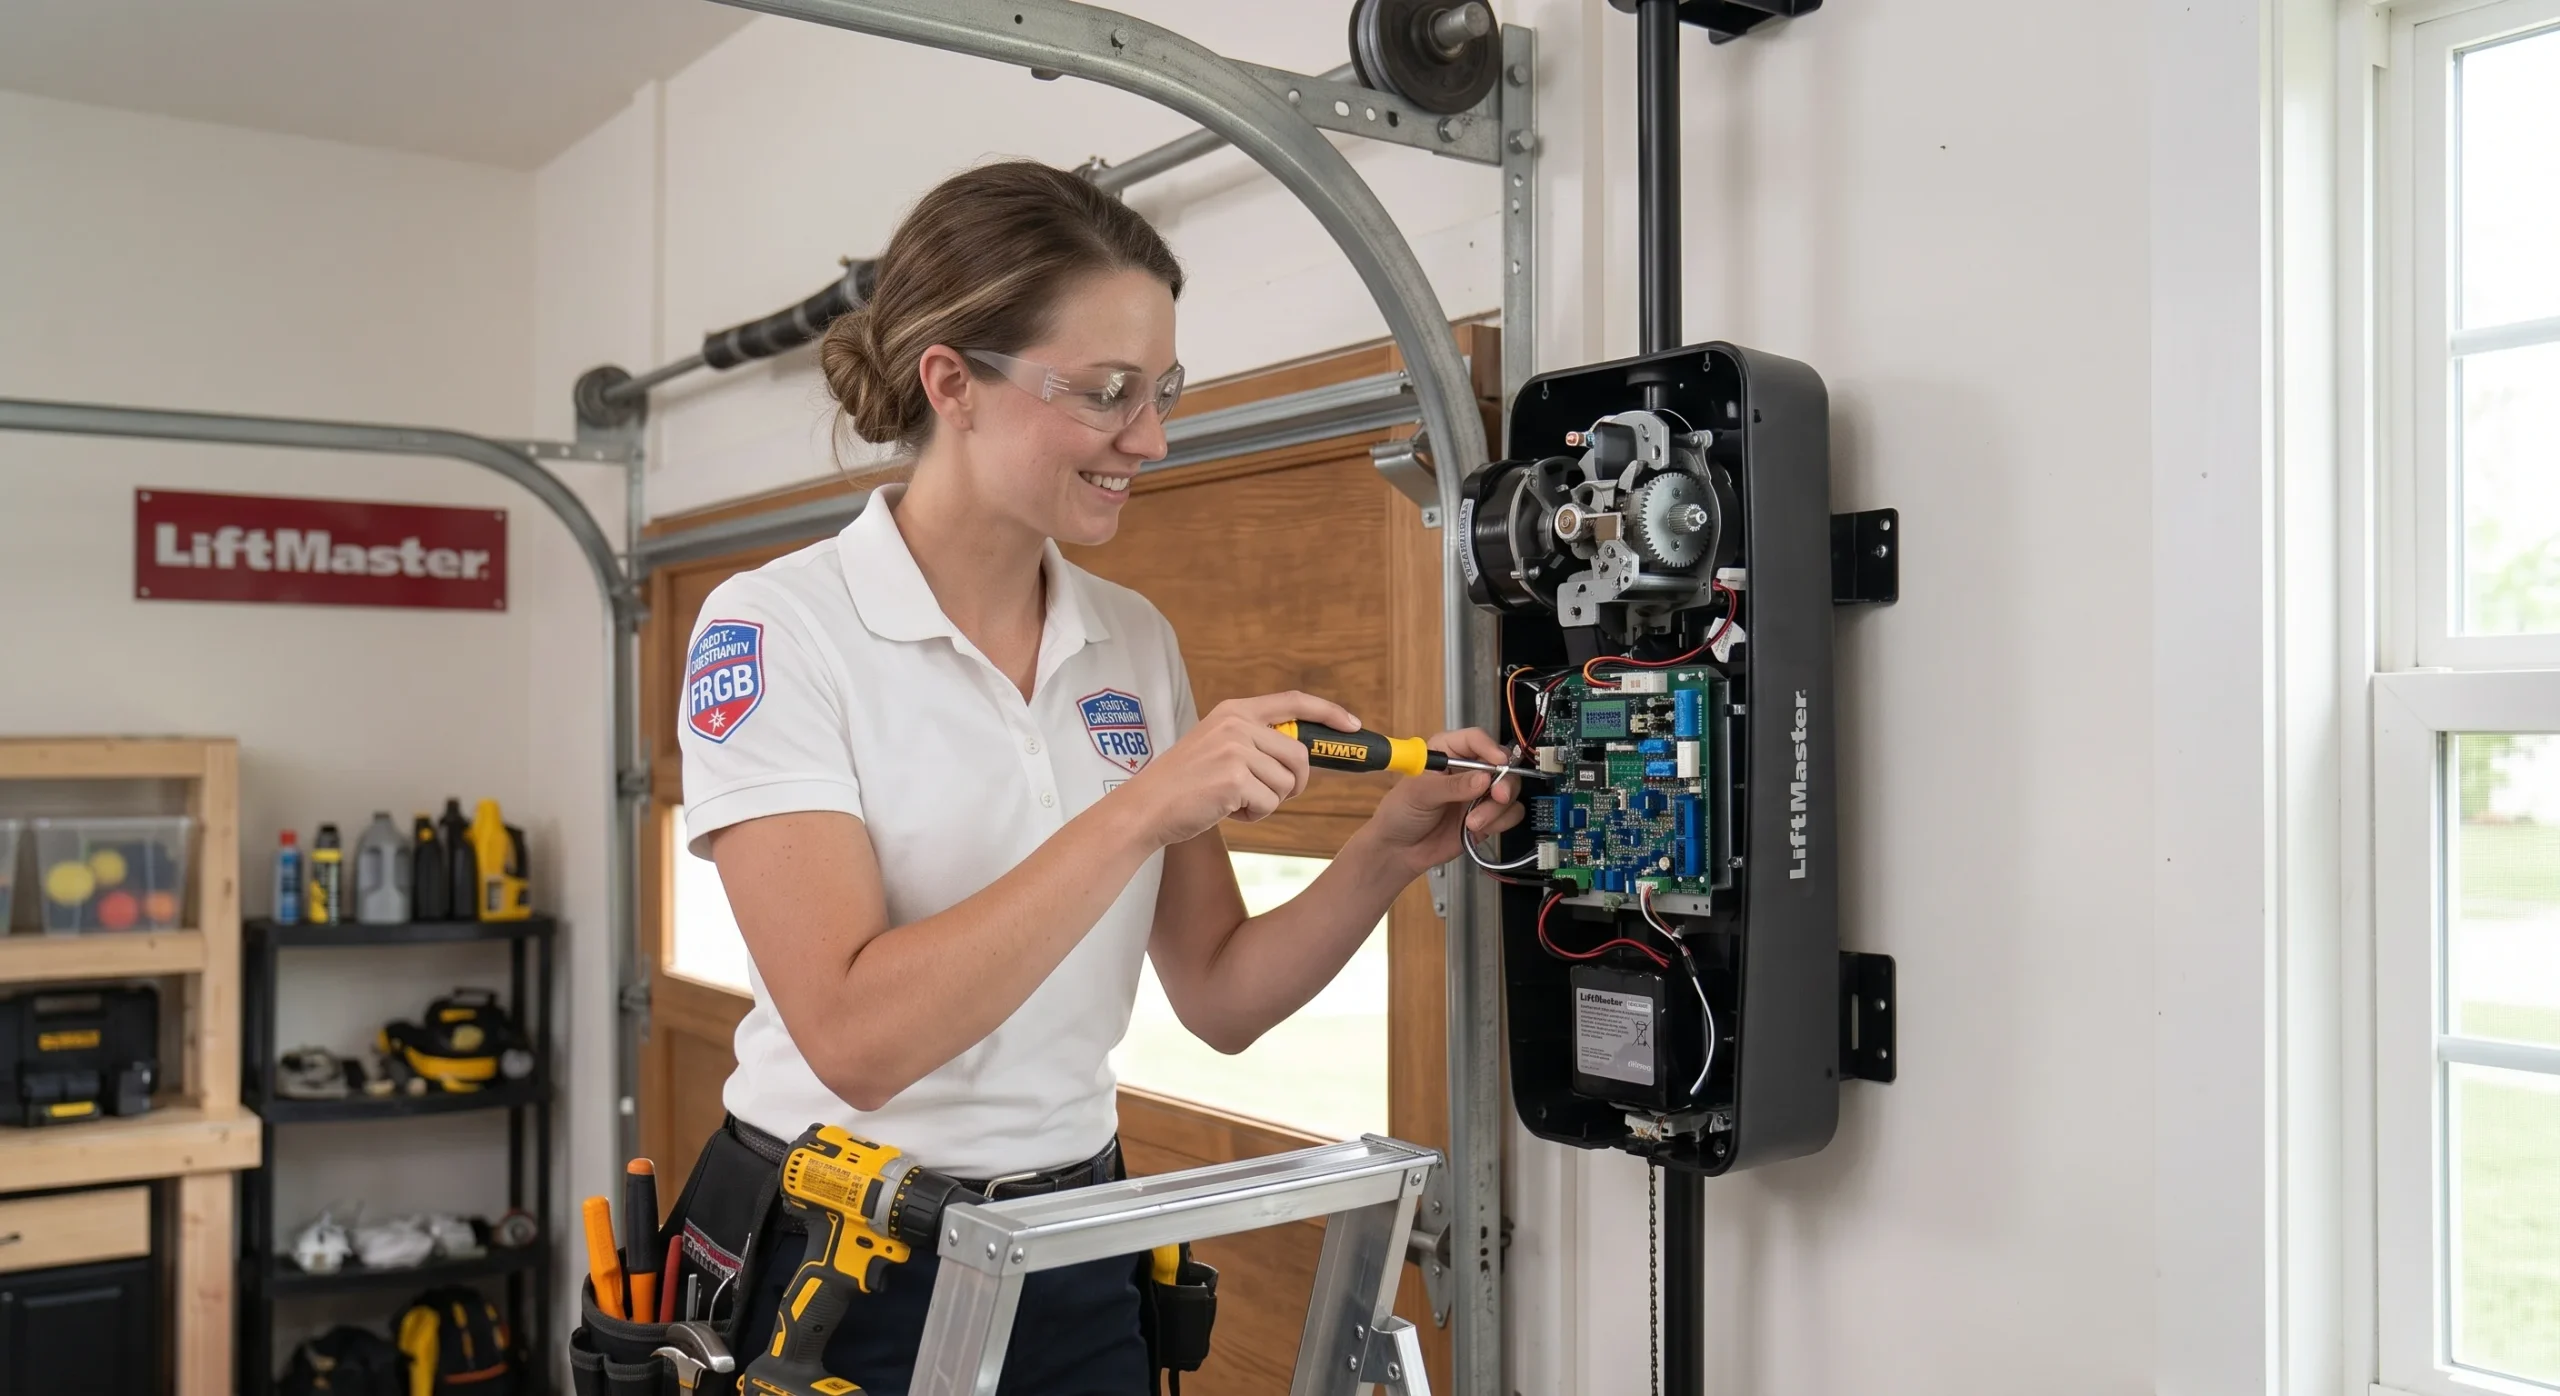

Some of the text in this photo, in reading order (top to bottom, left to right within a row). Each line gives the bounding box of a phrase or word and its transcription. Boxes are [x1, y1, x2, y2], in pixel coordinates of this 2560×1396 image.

[154, 522, 489, 580] LiftMaster
[690, 663, 755, 717] FRGB
[1096, 731, 1149, 756] FRGB
[1789, 689, 1808, 880] LiftMaster
